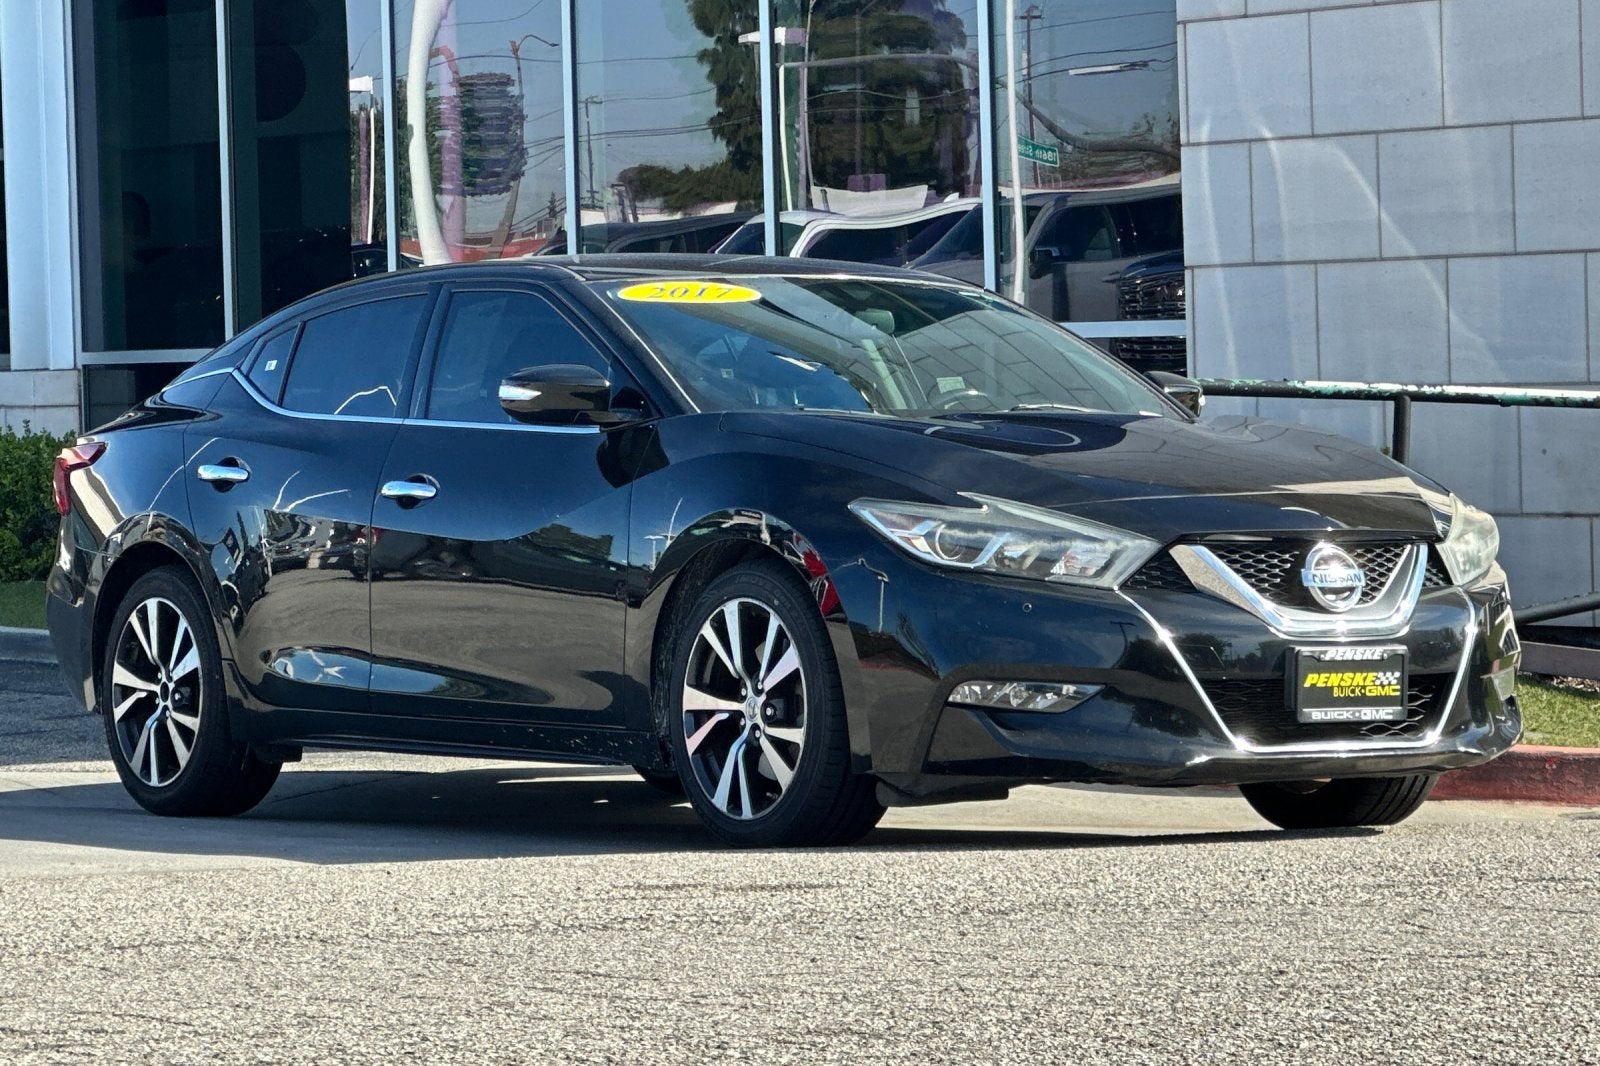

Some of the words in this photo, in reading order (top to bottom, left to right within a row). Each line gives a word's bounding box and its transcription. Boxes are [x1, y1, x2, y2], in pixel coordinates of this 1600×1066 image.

[647, 287, 735, 299] 2017
[1311, 571, 1362, 585] NISSAN
[1325, 649, 1384, 661] PENSKE
[1304, 672, 1378, 688] PENSKE
[1311, 710, 1353, 720] BUICK
[1360, 709, 1393, 720] GMC
